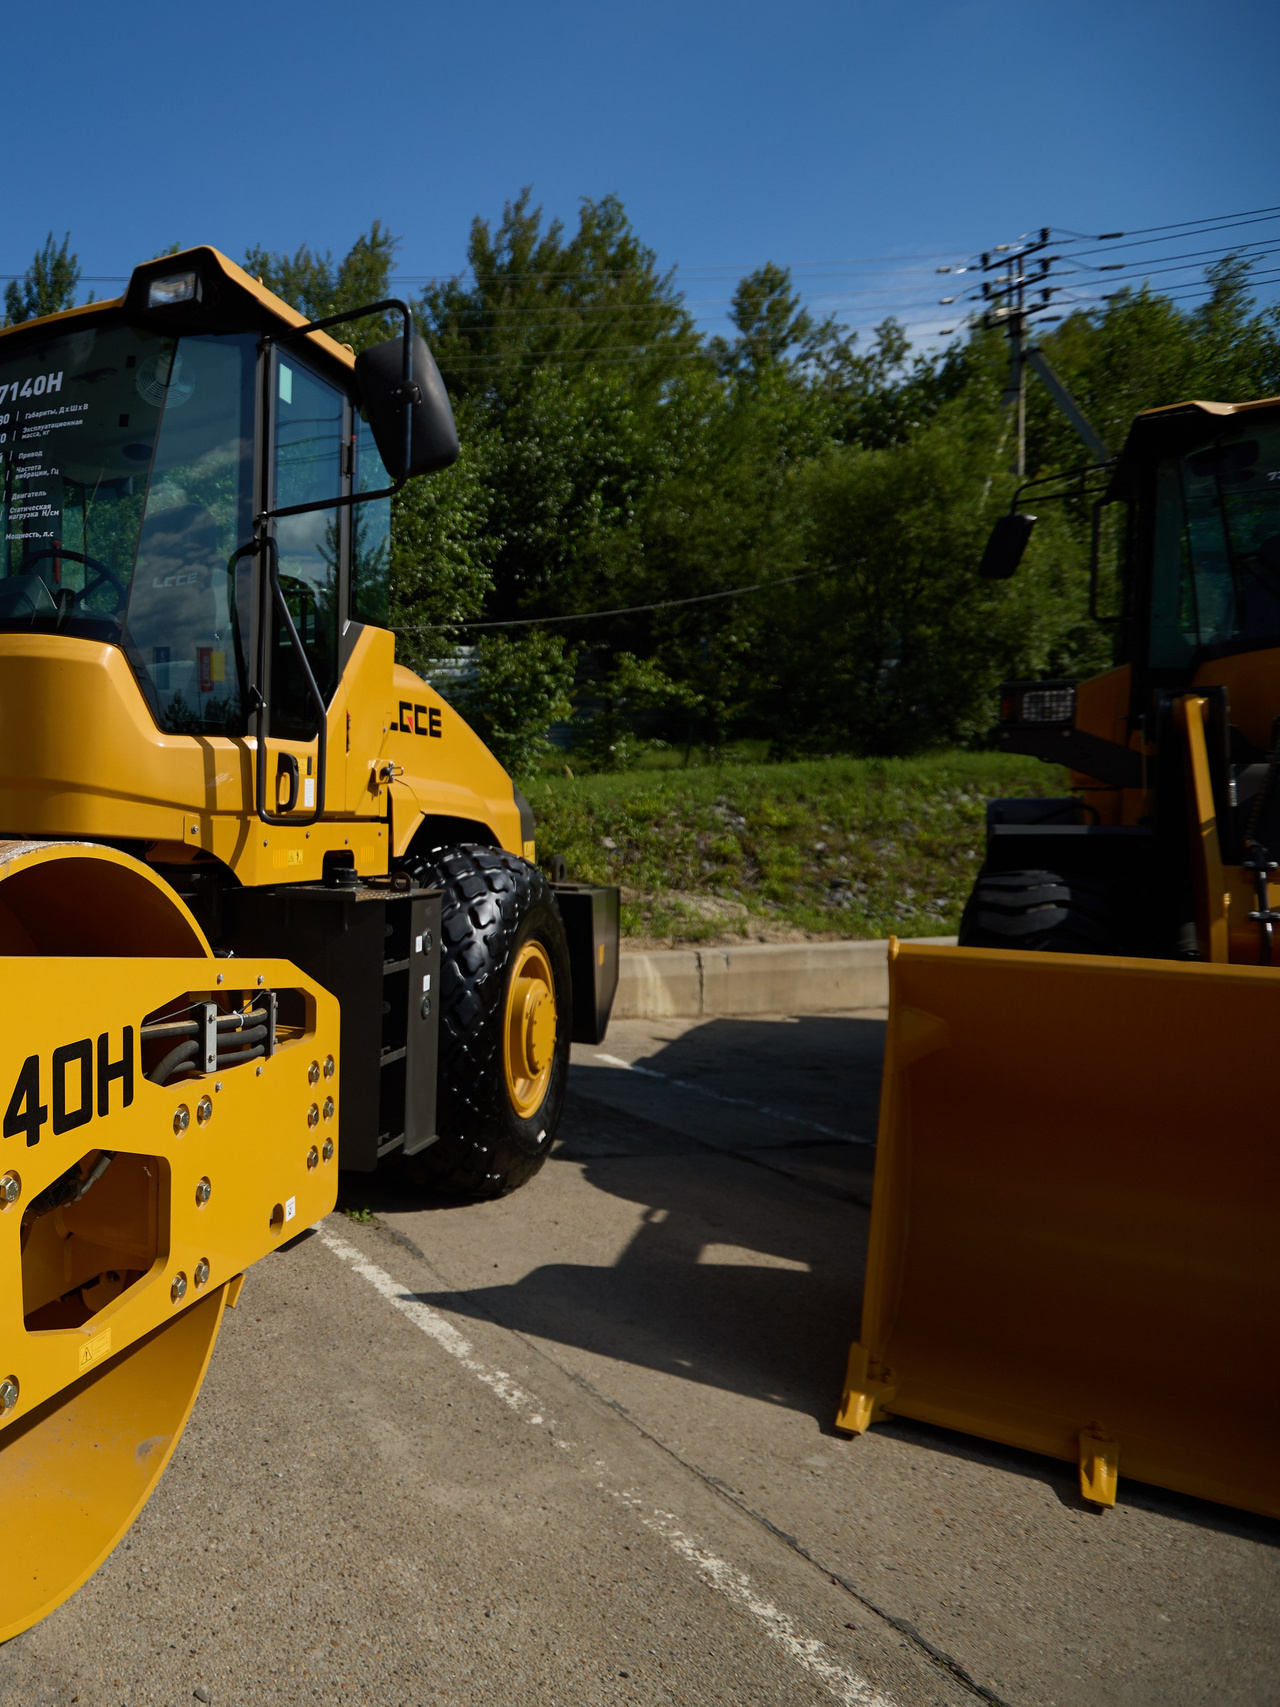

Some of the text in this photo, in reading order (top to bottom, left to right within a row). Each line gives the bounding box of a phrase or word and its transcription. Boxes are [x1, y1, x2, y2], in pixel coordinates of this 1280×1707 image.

[18, 450, 43, 460] Привод
[16, 464, 42, 473] Частота
[11, 490, 47, 501] Двигатель
[9, 504, 52, 513] Статическая
[8, 511, 39, 520] нагрузка
[5, 531, 42, 541] Мощность,
